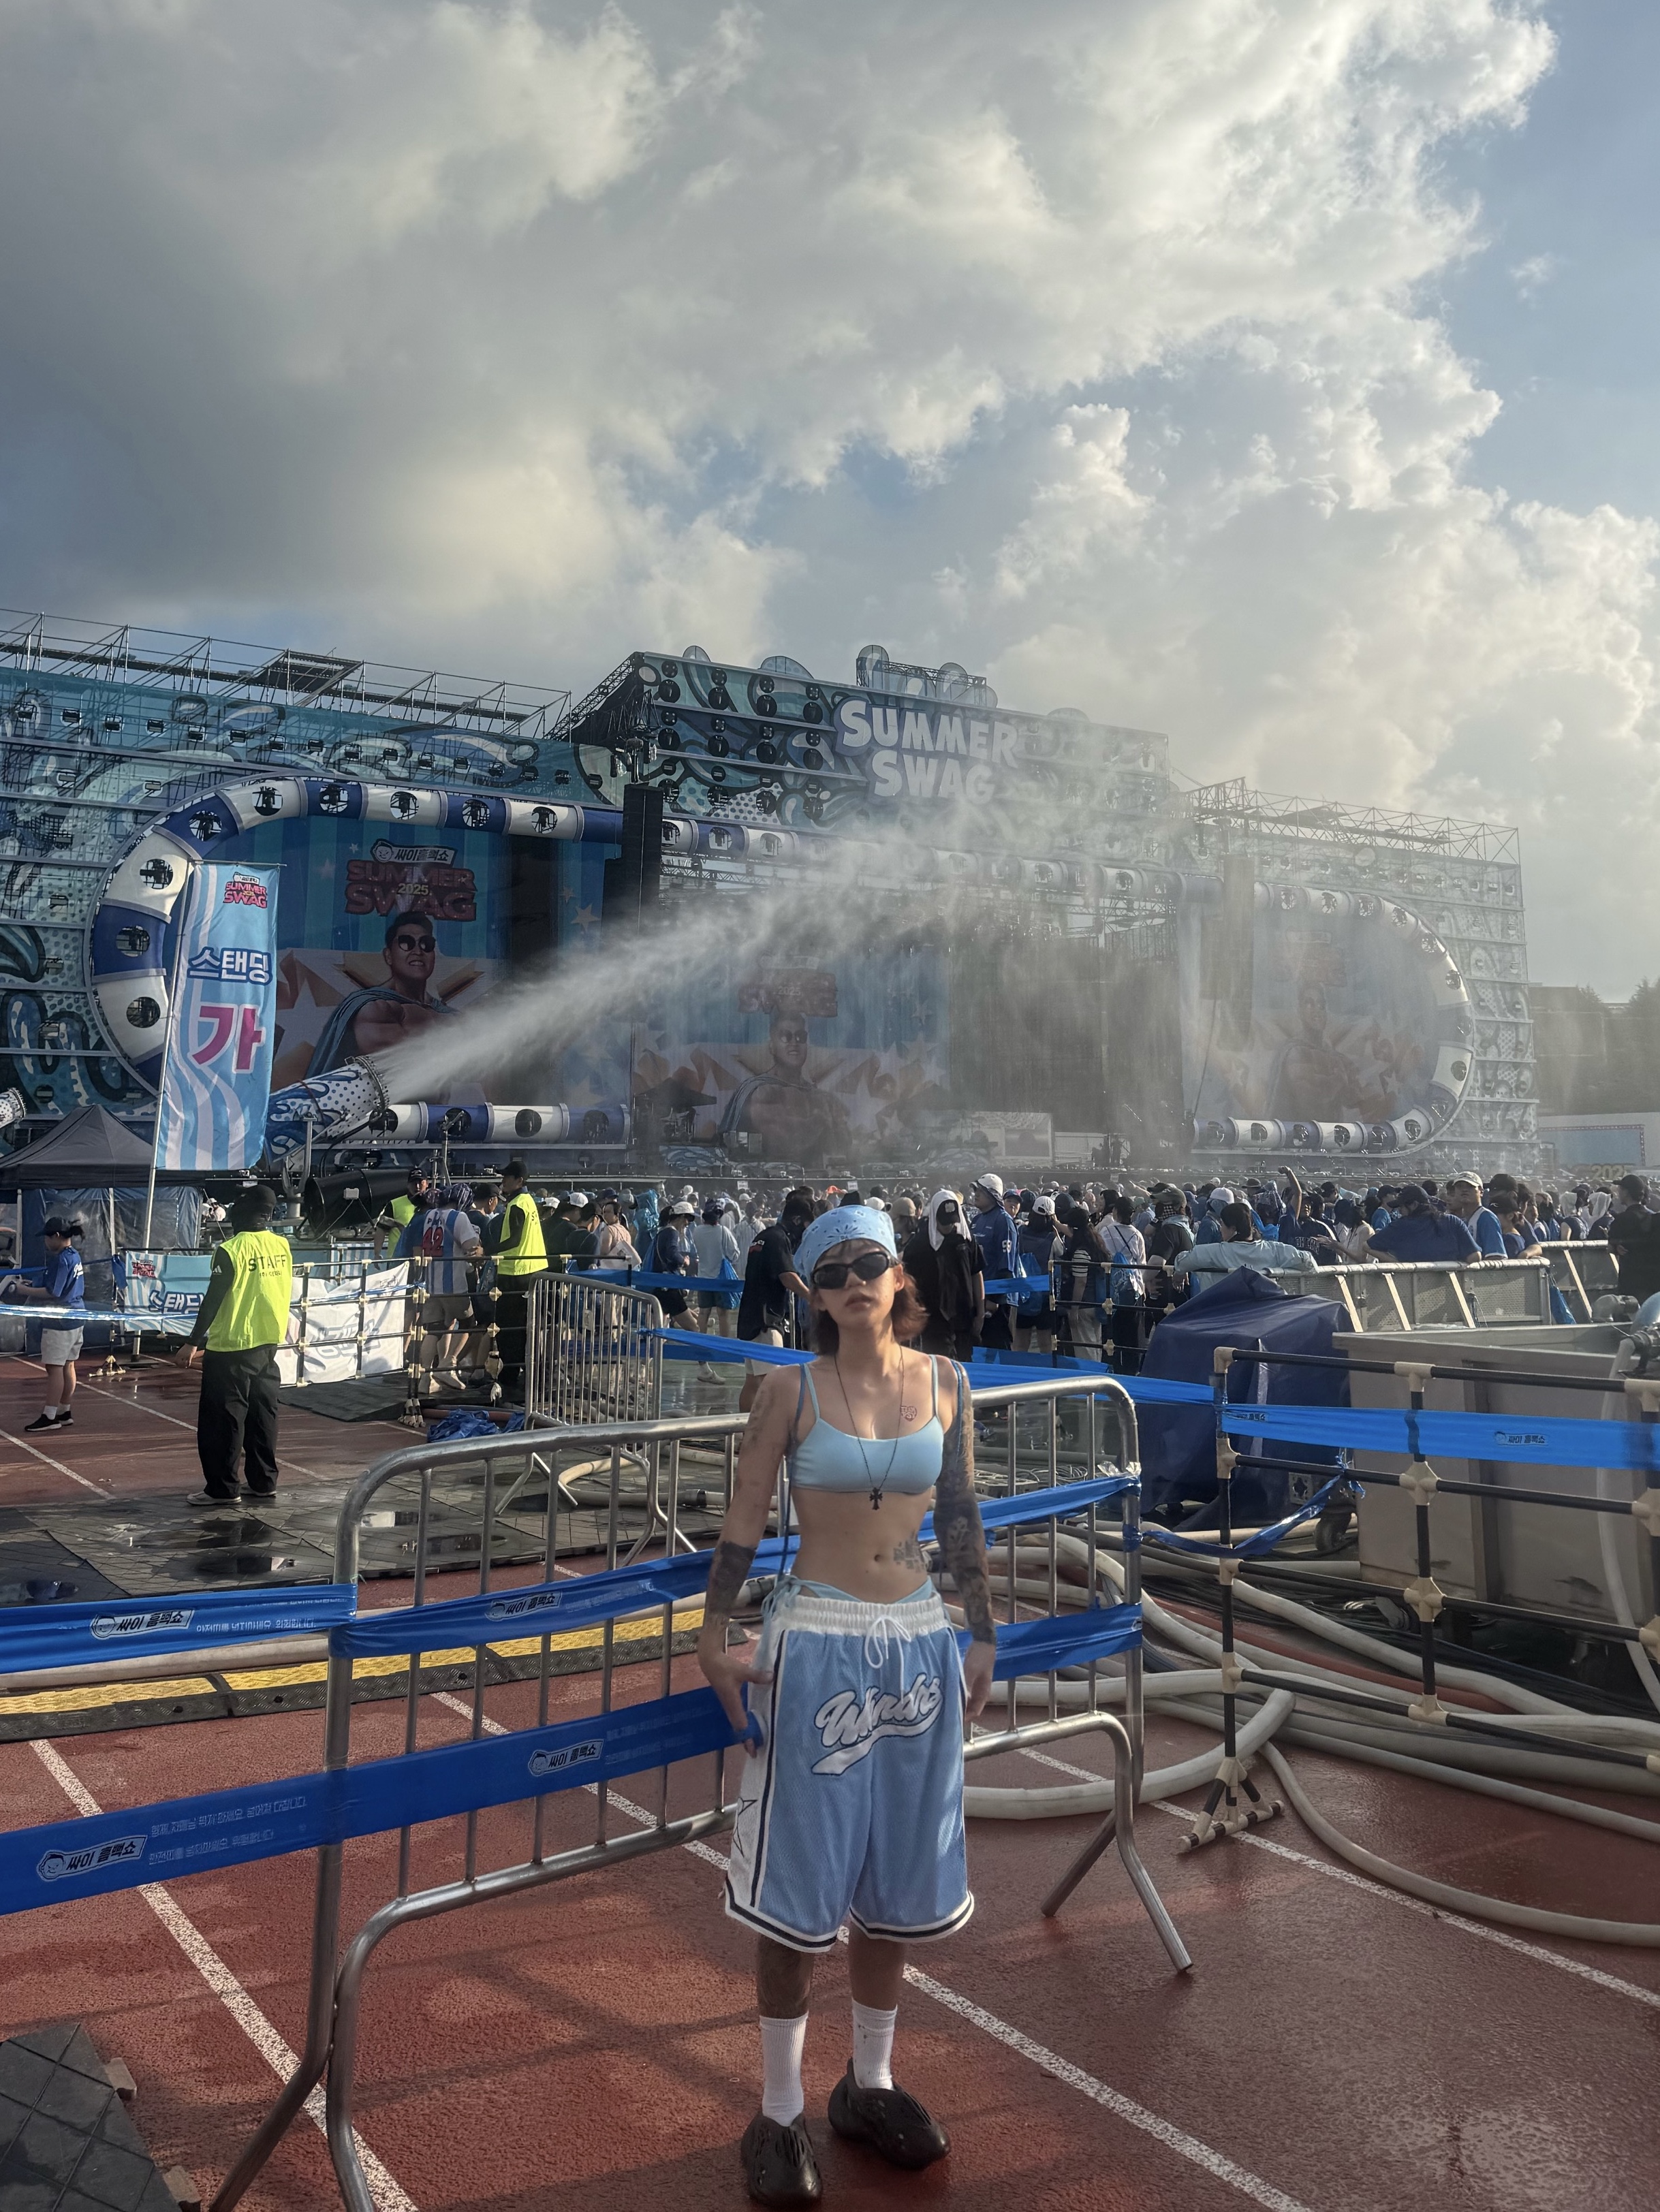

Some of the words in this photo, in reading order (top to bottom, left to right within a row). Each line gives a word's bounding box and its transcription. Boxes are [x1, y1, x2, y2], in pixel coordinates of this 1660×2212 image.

[840, 699, 1019, 769] SUMMER
[871, 749, 995, 805] SWAG
[225, 882, 268, 896] SUMMER
[347, 859, 477, 893] SUMMER
[397, 883, 429, 896] 2025
[223, 891, 268, 908] SWAG
[345, 882, 476, 921] SWAG
[189, 948, 271, 985] 스탠딩
[191, 1005, 262, 1071] 가
[248, 1254, 286, 1272] STAFF
[116, 1615, 145, 1632] 싸이
[65, 1850, 96, 1871] 싸이
